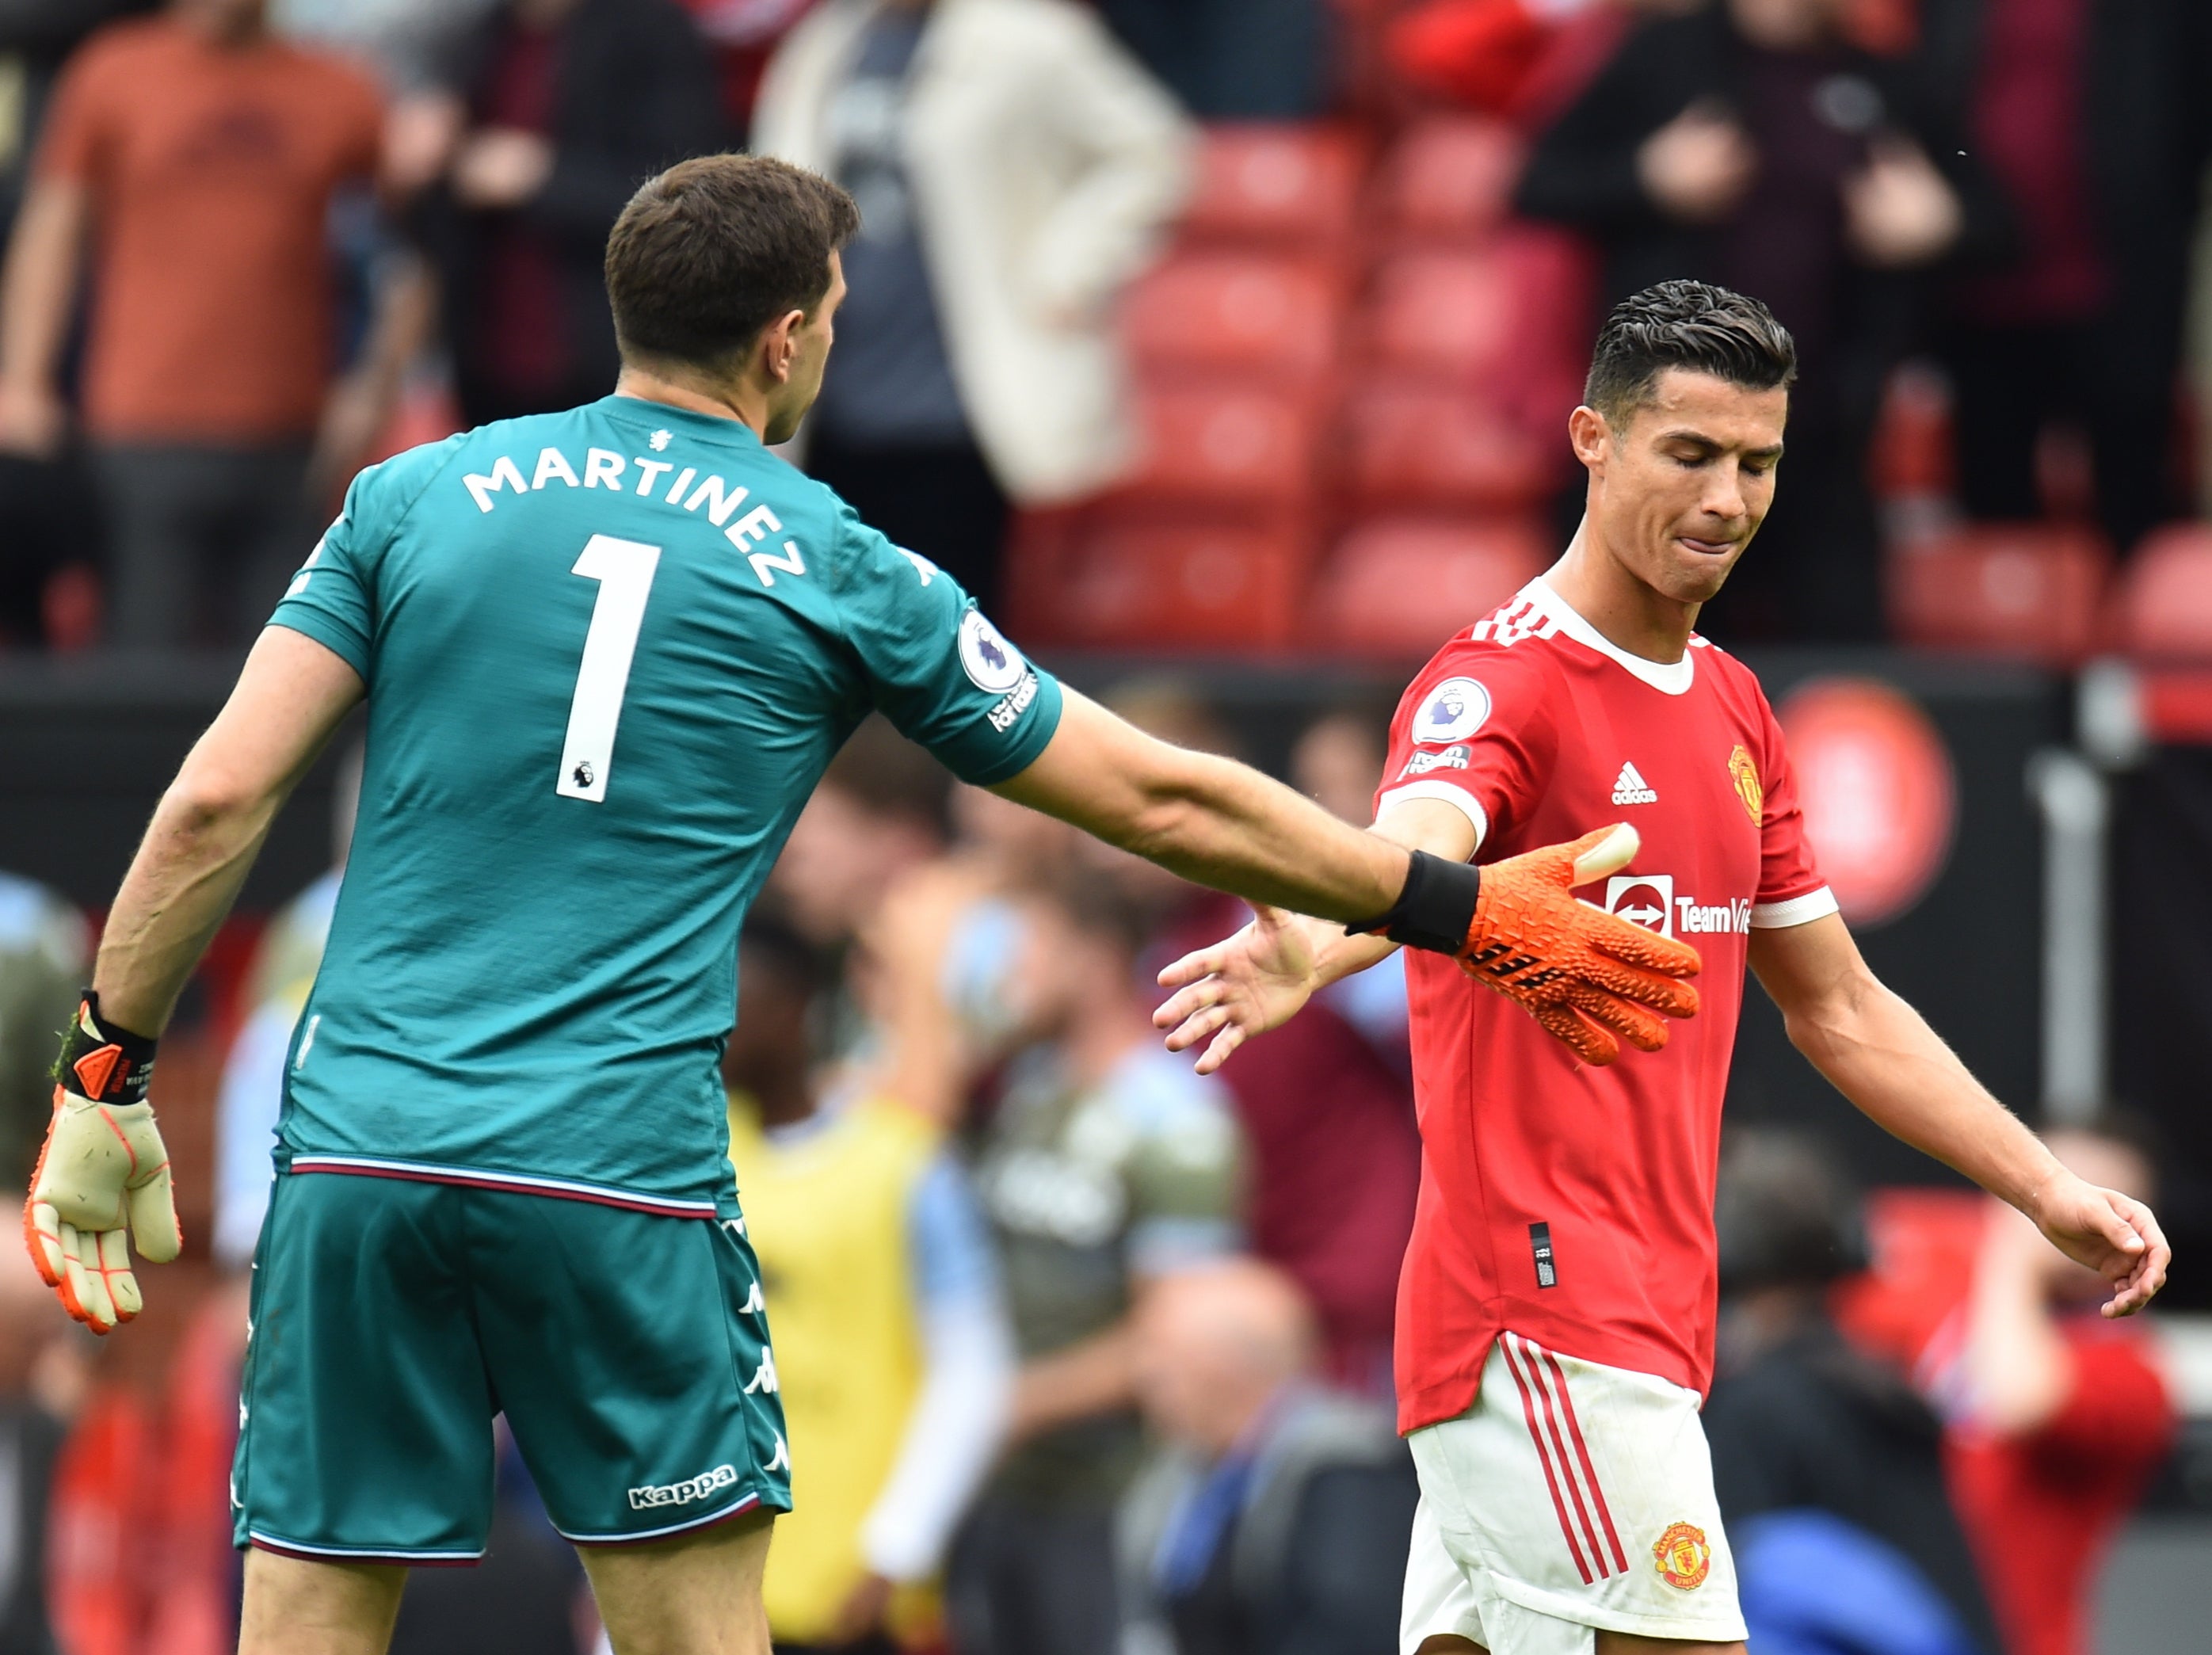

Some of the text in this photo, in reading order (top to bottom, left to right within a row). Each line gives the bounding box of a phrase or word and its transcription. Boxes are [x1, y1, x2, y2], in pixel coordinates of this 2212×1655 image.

[462, 447, 806, 588] MARTINEZ
[556, 533, 662, 803] 1
[1611, 789, 1657, 805] adidas
[628, 1464, 738, 1509] Kappa
